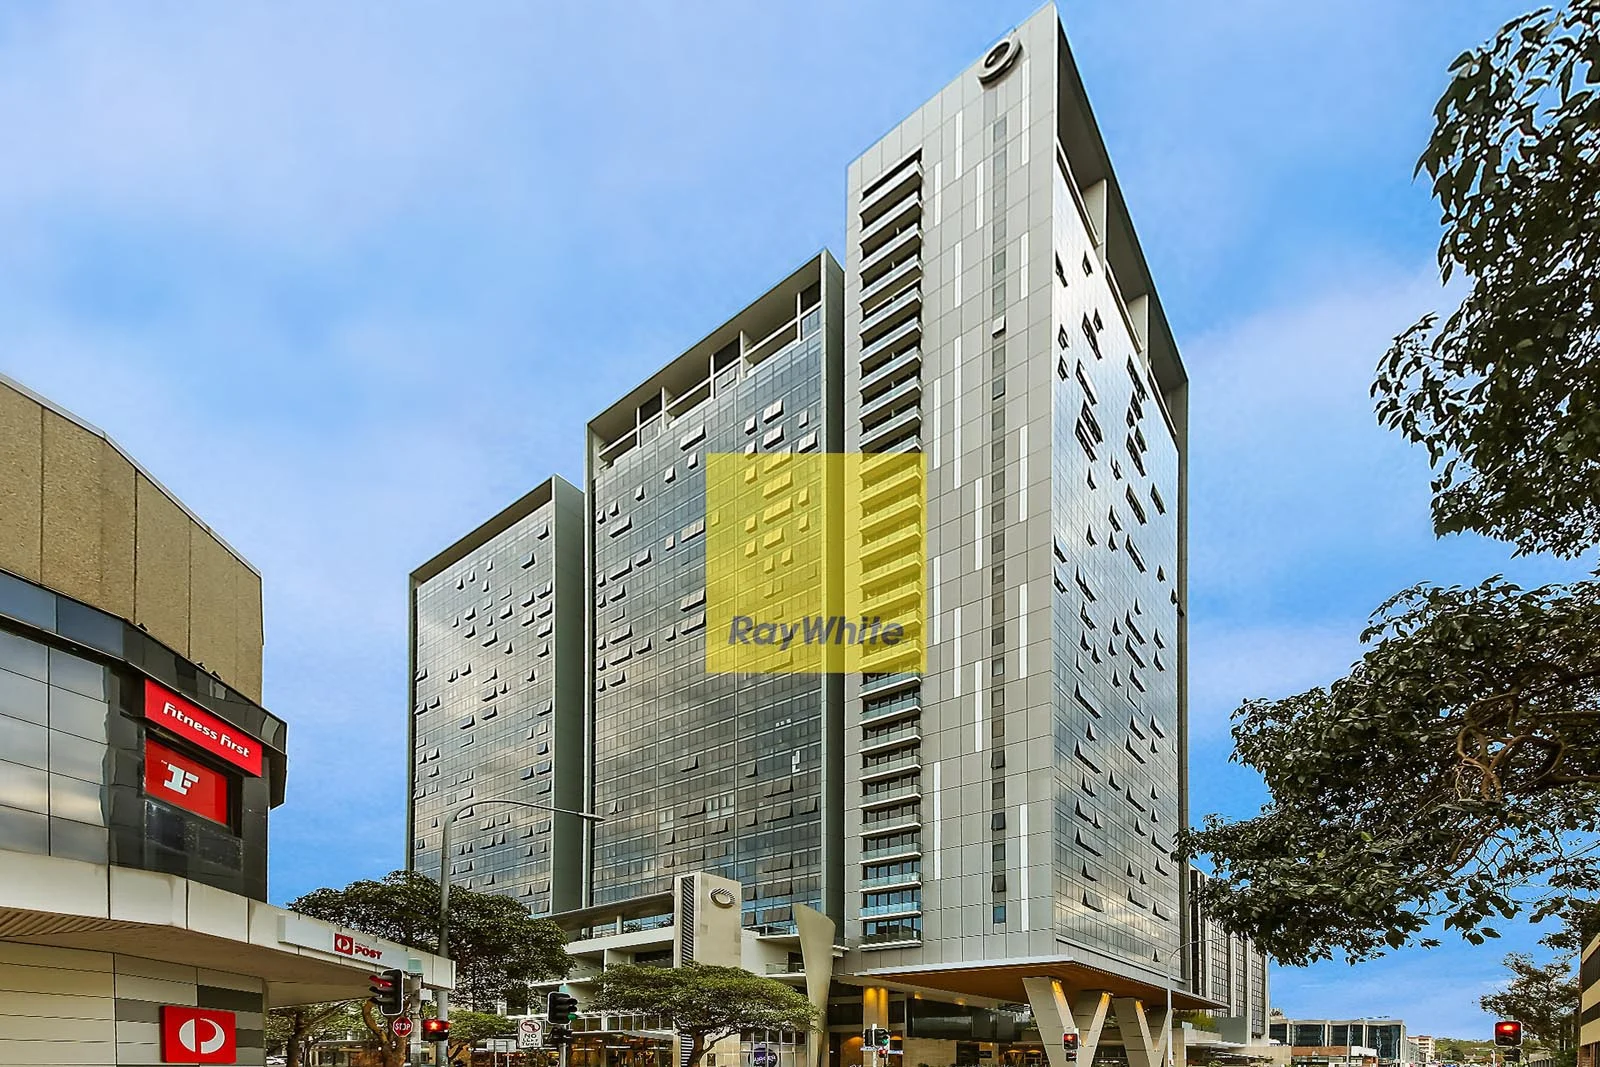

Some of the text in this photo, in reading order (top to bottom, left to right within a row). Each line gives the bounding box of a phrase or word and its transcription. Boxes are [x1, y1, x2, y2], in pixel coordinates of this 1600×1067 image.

[163, 702, 250, 758] Fitness First
[355, 945, 383, 960] POST
[394, 1023, 411, 1031] STOP
